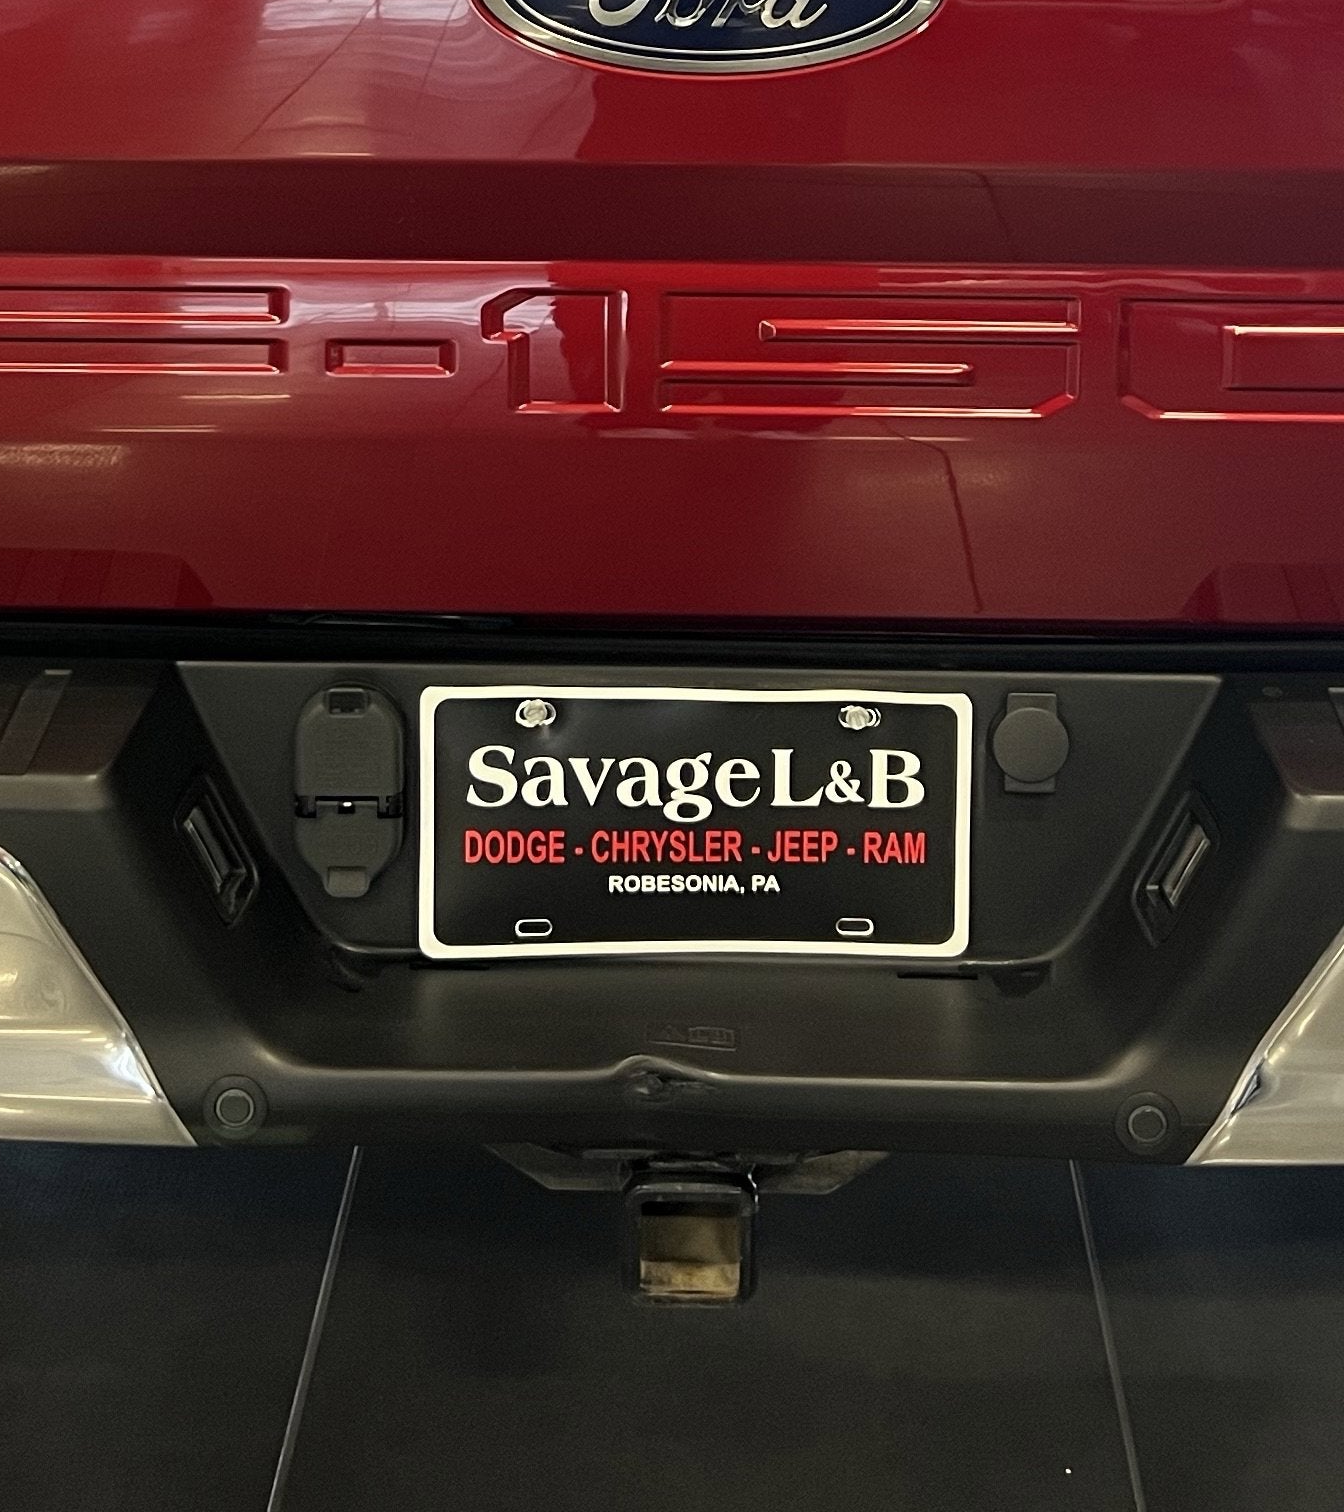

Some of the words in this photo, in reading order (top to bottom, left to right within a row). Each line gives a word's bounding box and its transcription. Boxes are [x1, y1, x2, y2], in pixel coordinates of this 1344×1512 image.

[464, 829, 566, 864] DODGE
[590, 829, 743, 864] CHRYSLER
[767, 829, 839, 864] JEEP
[863, 830, 927, 865] RAM
[608, 874, 746, 895] ROBESONIA,
[751, 874, 781, 893] PA
